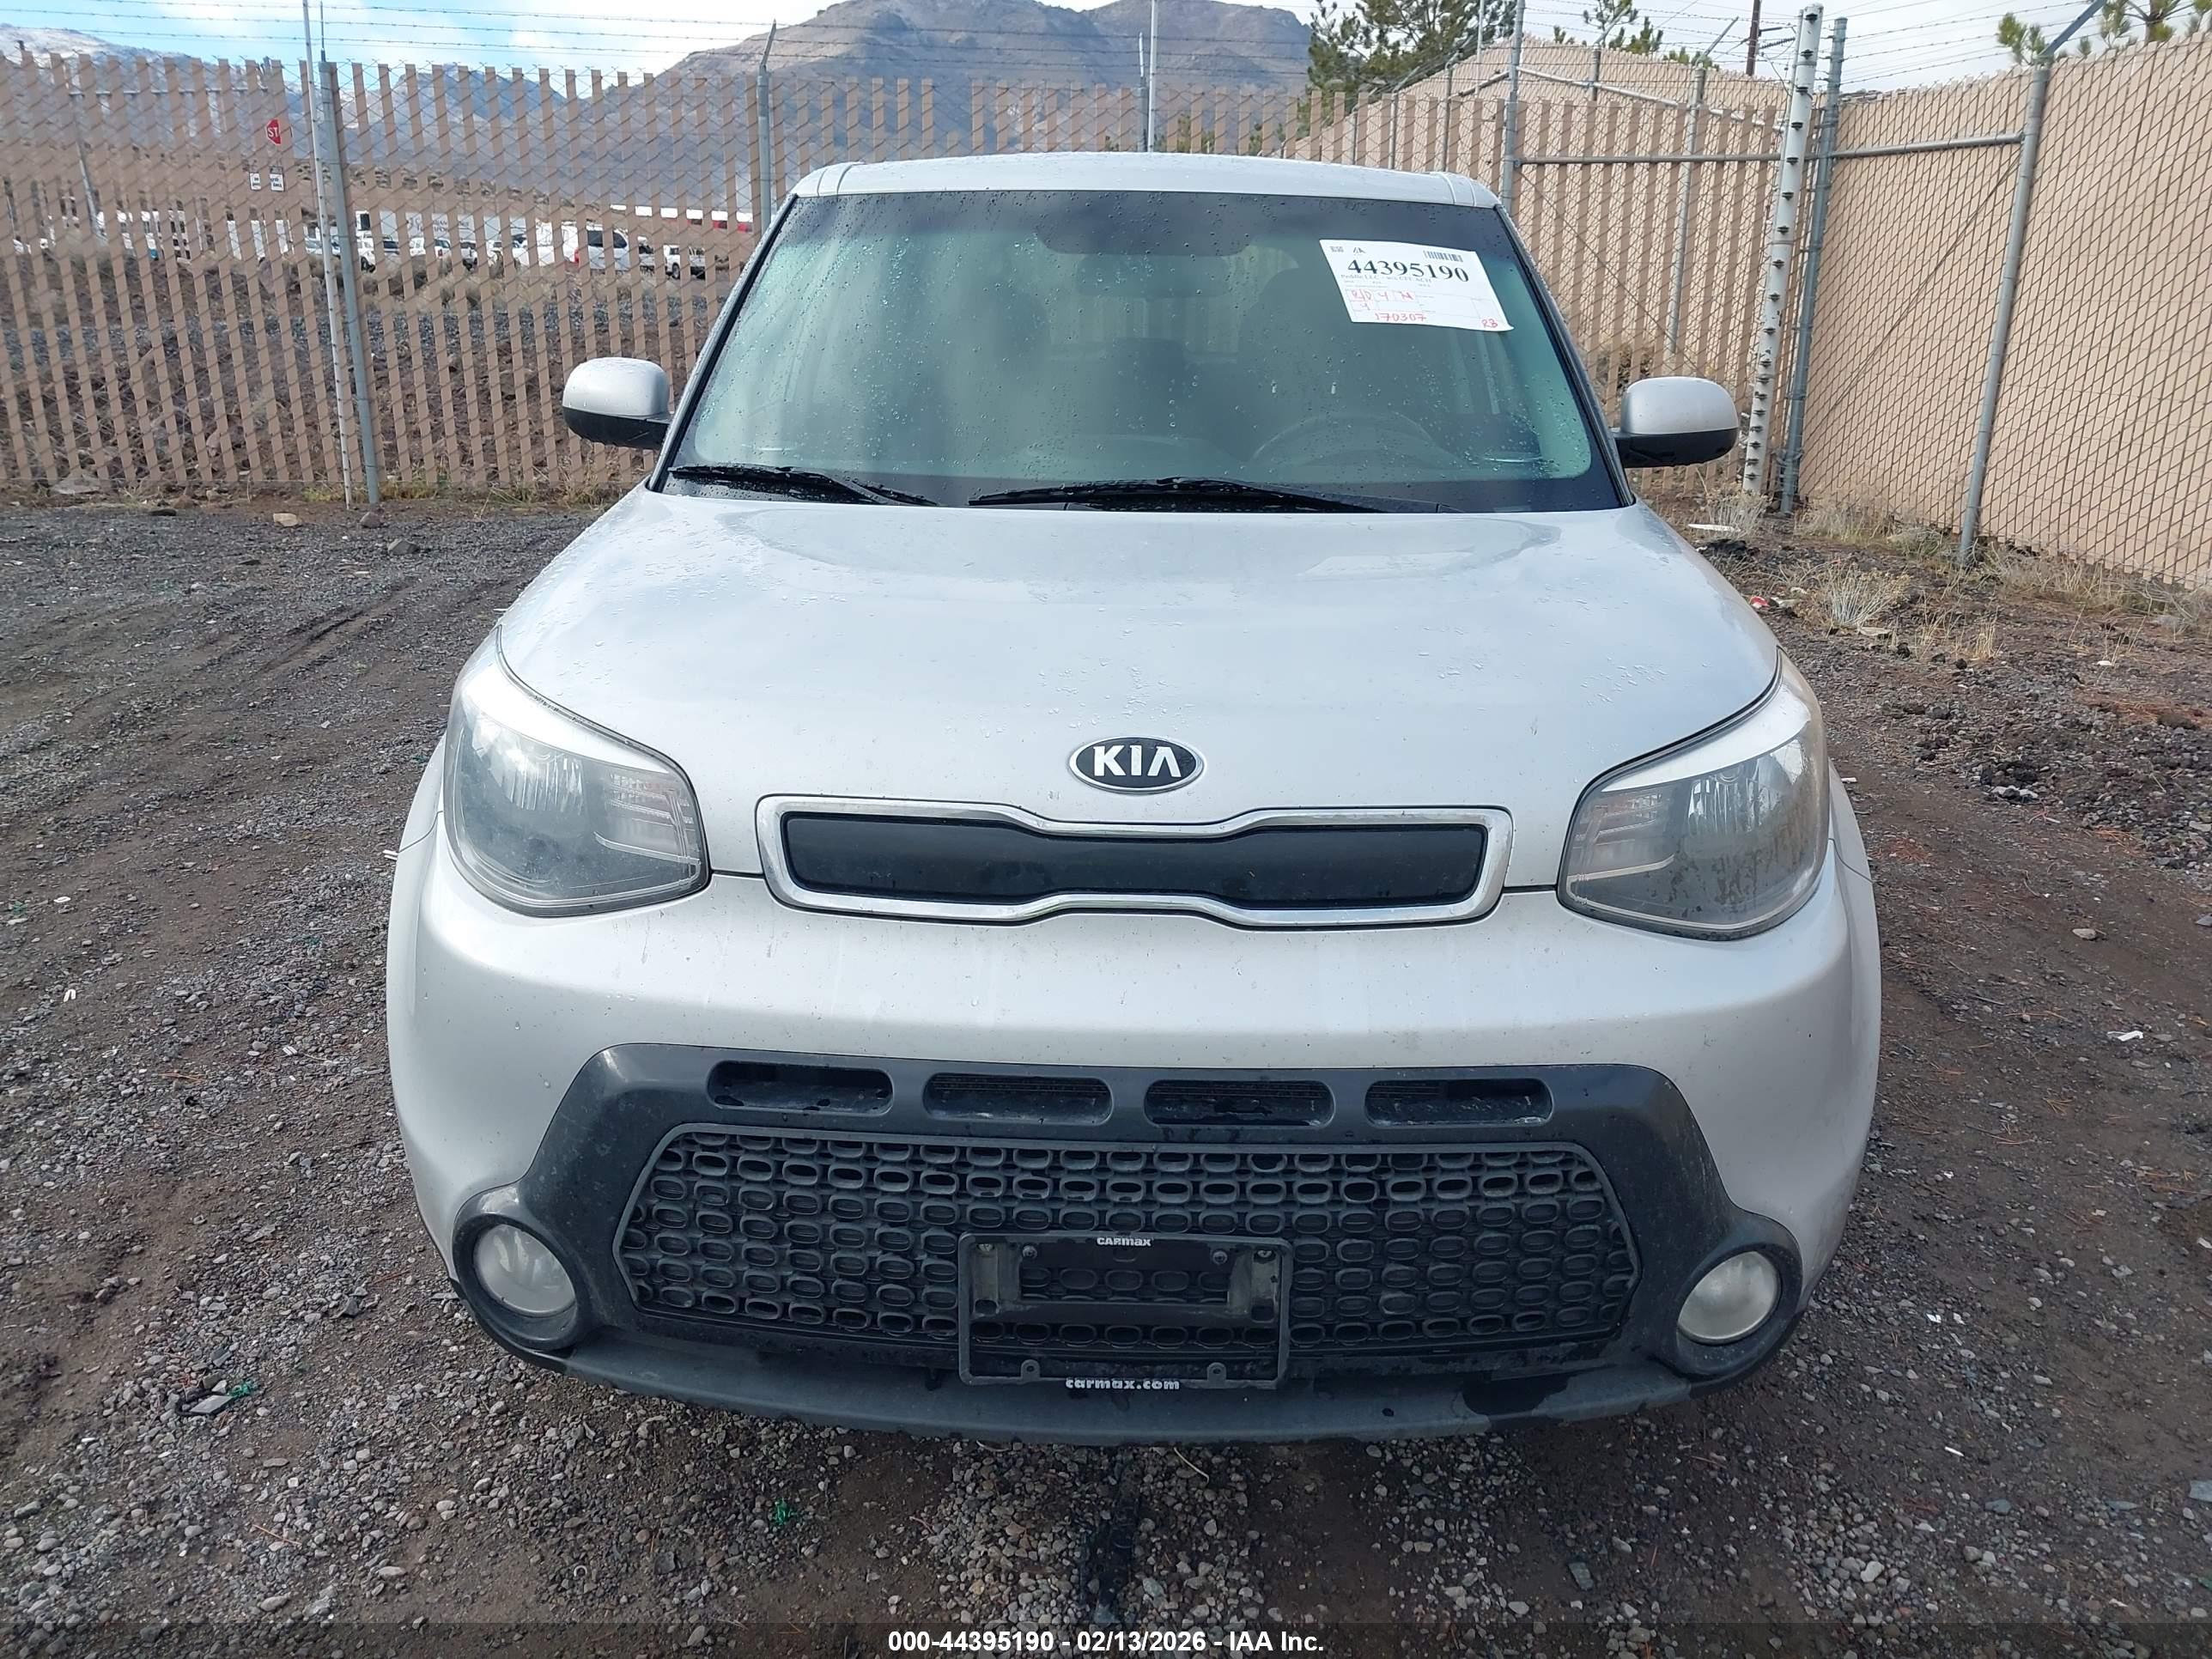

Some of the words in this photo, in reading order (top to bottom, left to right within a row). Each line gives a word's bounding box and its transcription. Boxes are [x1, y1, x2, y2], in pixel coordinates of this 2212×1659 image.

[268, 127, 278, 137] ST
[1347, 259, 1469, 283] 44395190
[1374, 312, 1426, 322] 170307
[1092, 744, 1182, 778] KIA
[1066, 1377, 1180, 1390] carmax.com
